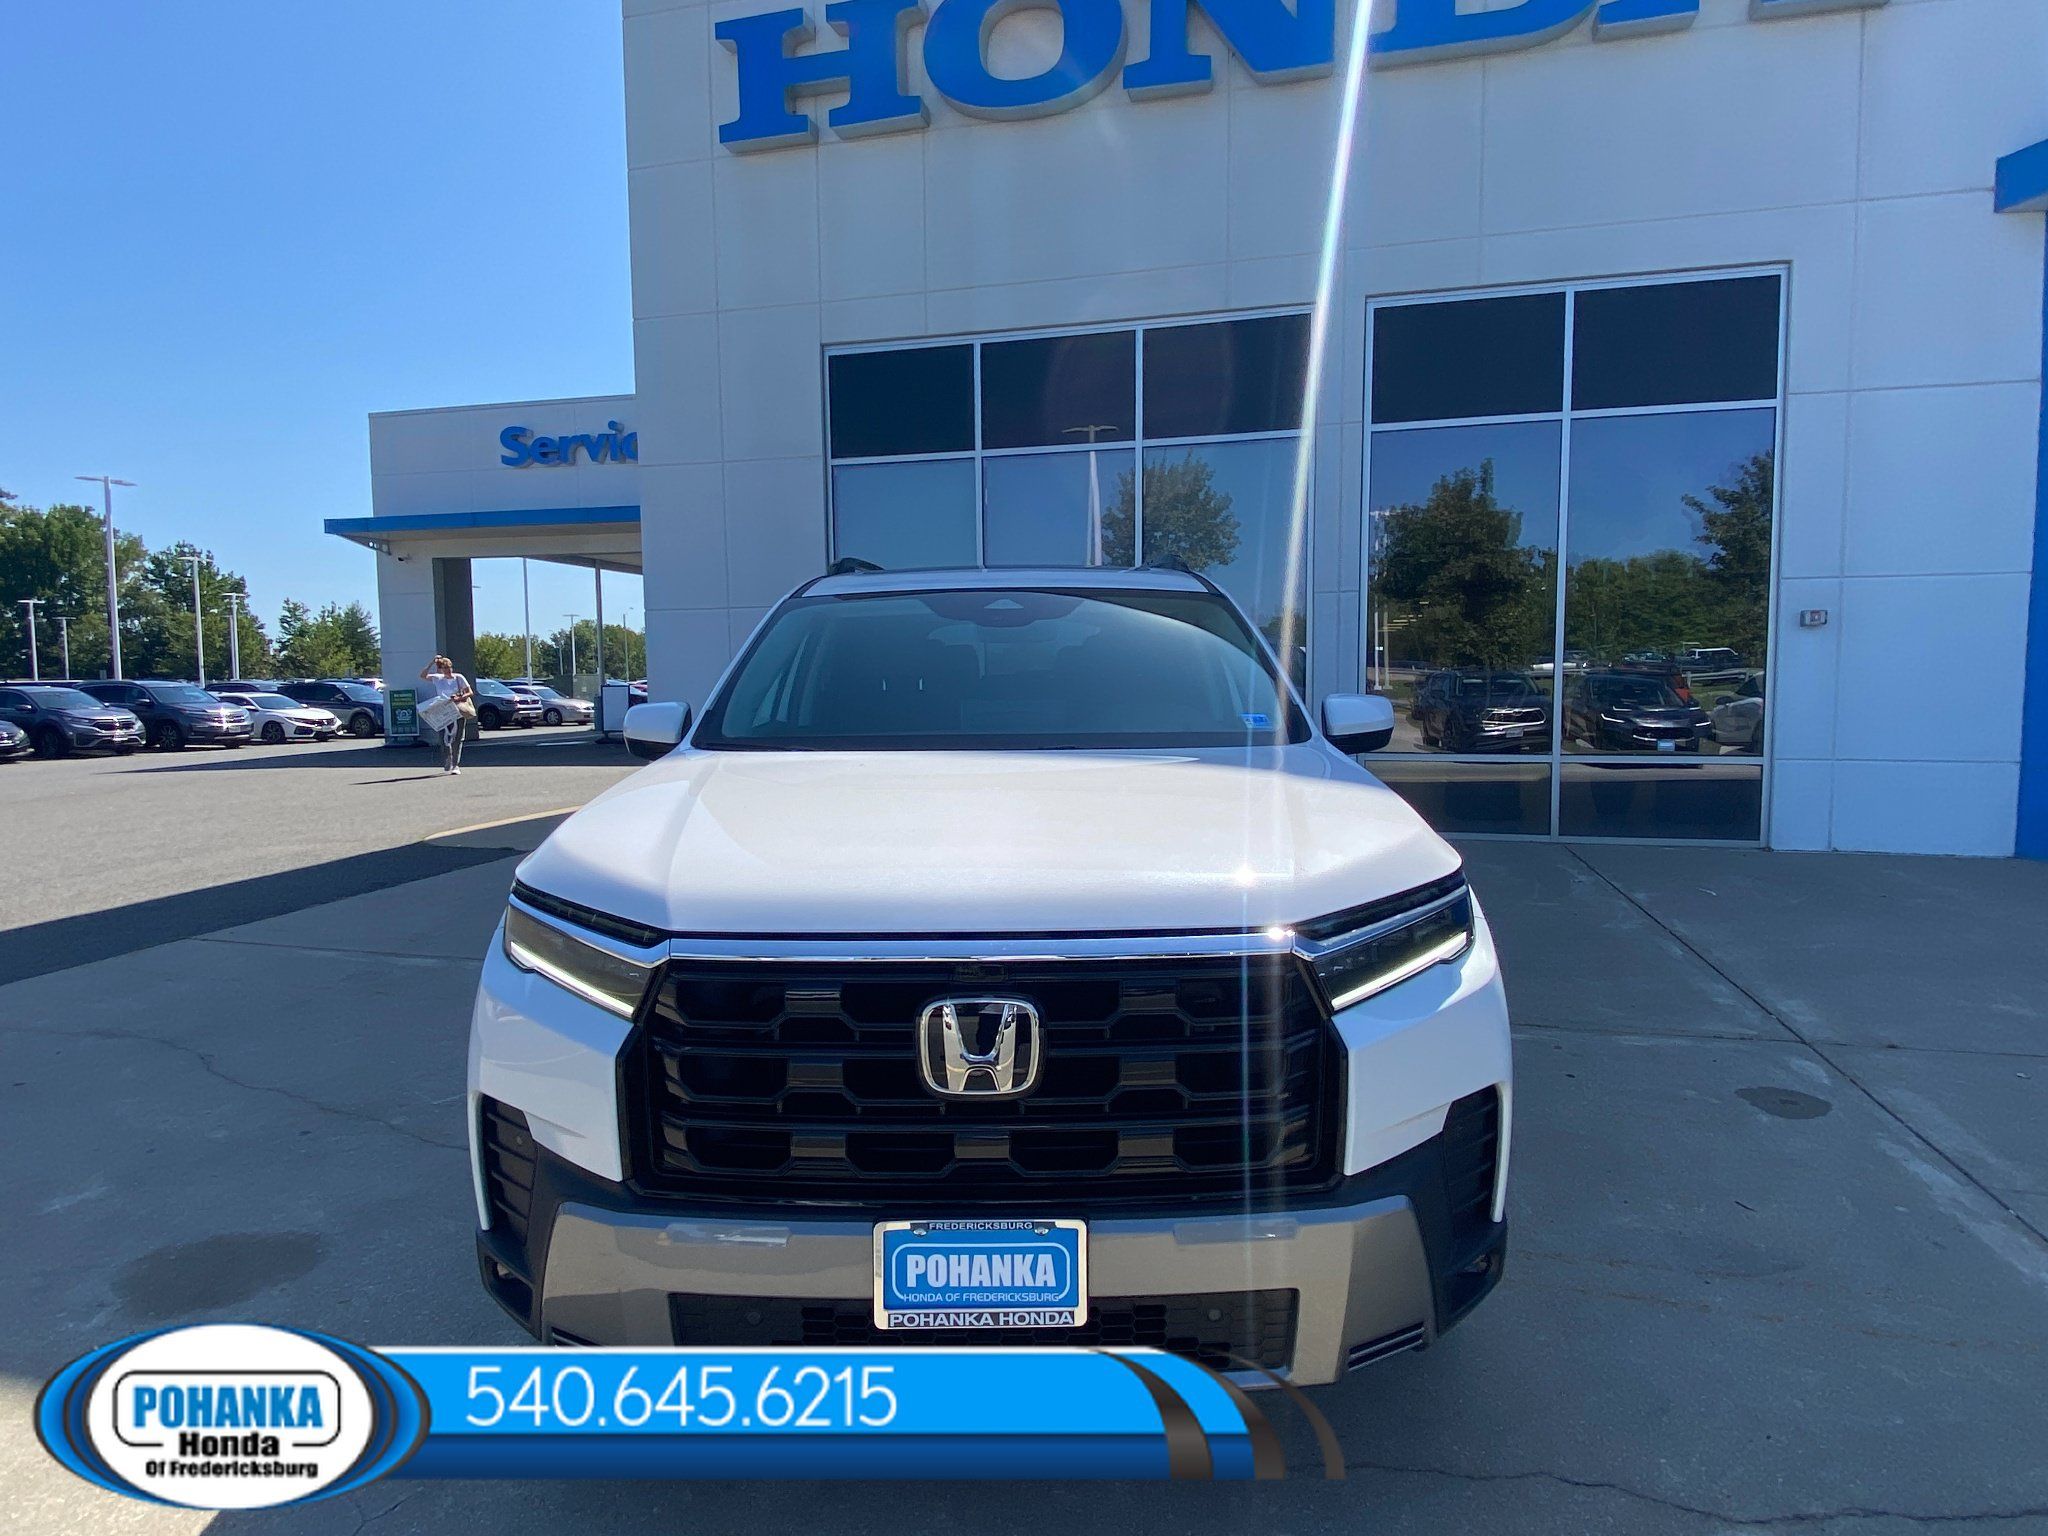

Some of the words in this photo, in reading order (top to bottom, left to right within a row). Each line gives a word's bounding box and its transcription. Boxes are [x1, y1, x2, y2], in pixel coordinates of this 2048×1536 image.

[929, 1222, 1033, 1230] FREDERICKSBURG
[906, 1254, 1056, 1287] POHANKA
[903, 1294, 943, 1302] HONDA
[945, 1293, 960, 1302] OF
[963, 1293, 1059, 1302] FREDERICKSBURG
[890, 1313, 994, 1326] POHANKA
[1000, 1311, 1074, 1325] HONDA
